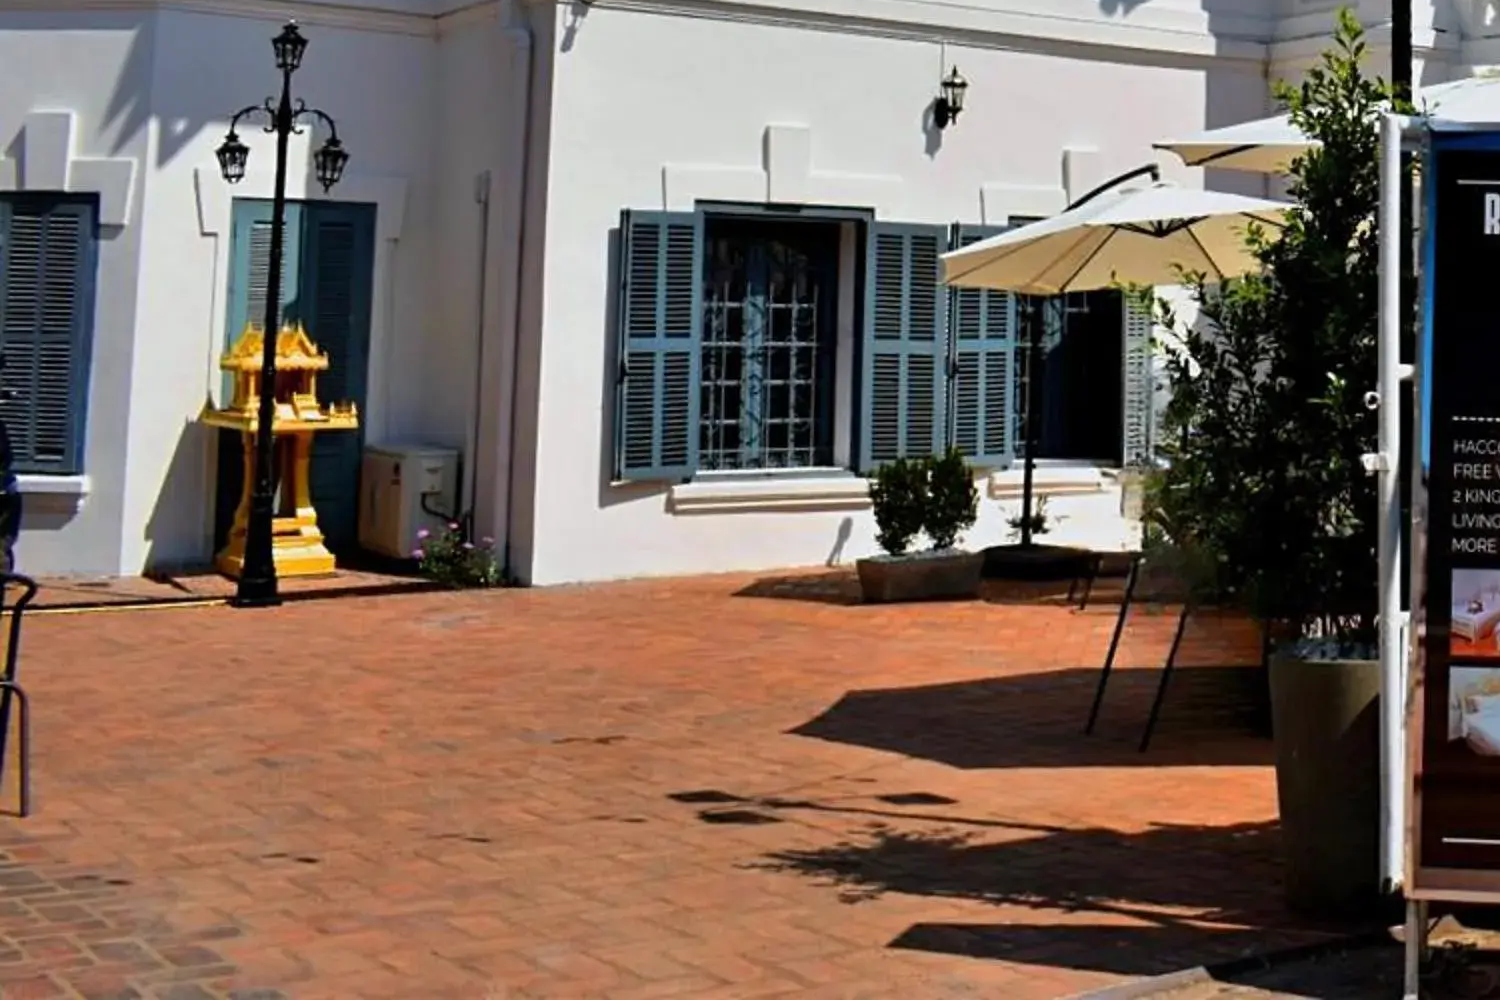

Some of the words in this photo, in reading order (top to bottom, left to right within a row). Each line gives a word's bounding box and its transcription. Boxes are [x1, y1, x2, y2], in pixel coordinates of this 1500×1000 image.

[1453, 463, 1493, 480] FREE
[1452, 490, 1462, 503] 2
[1451, 537, 1498, 553] MORE
